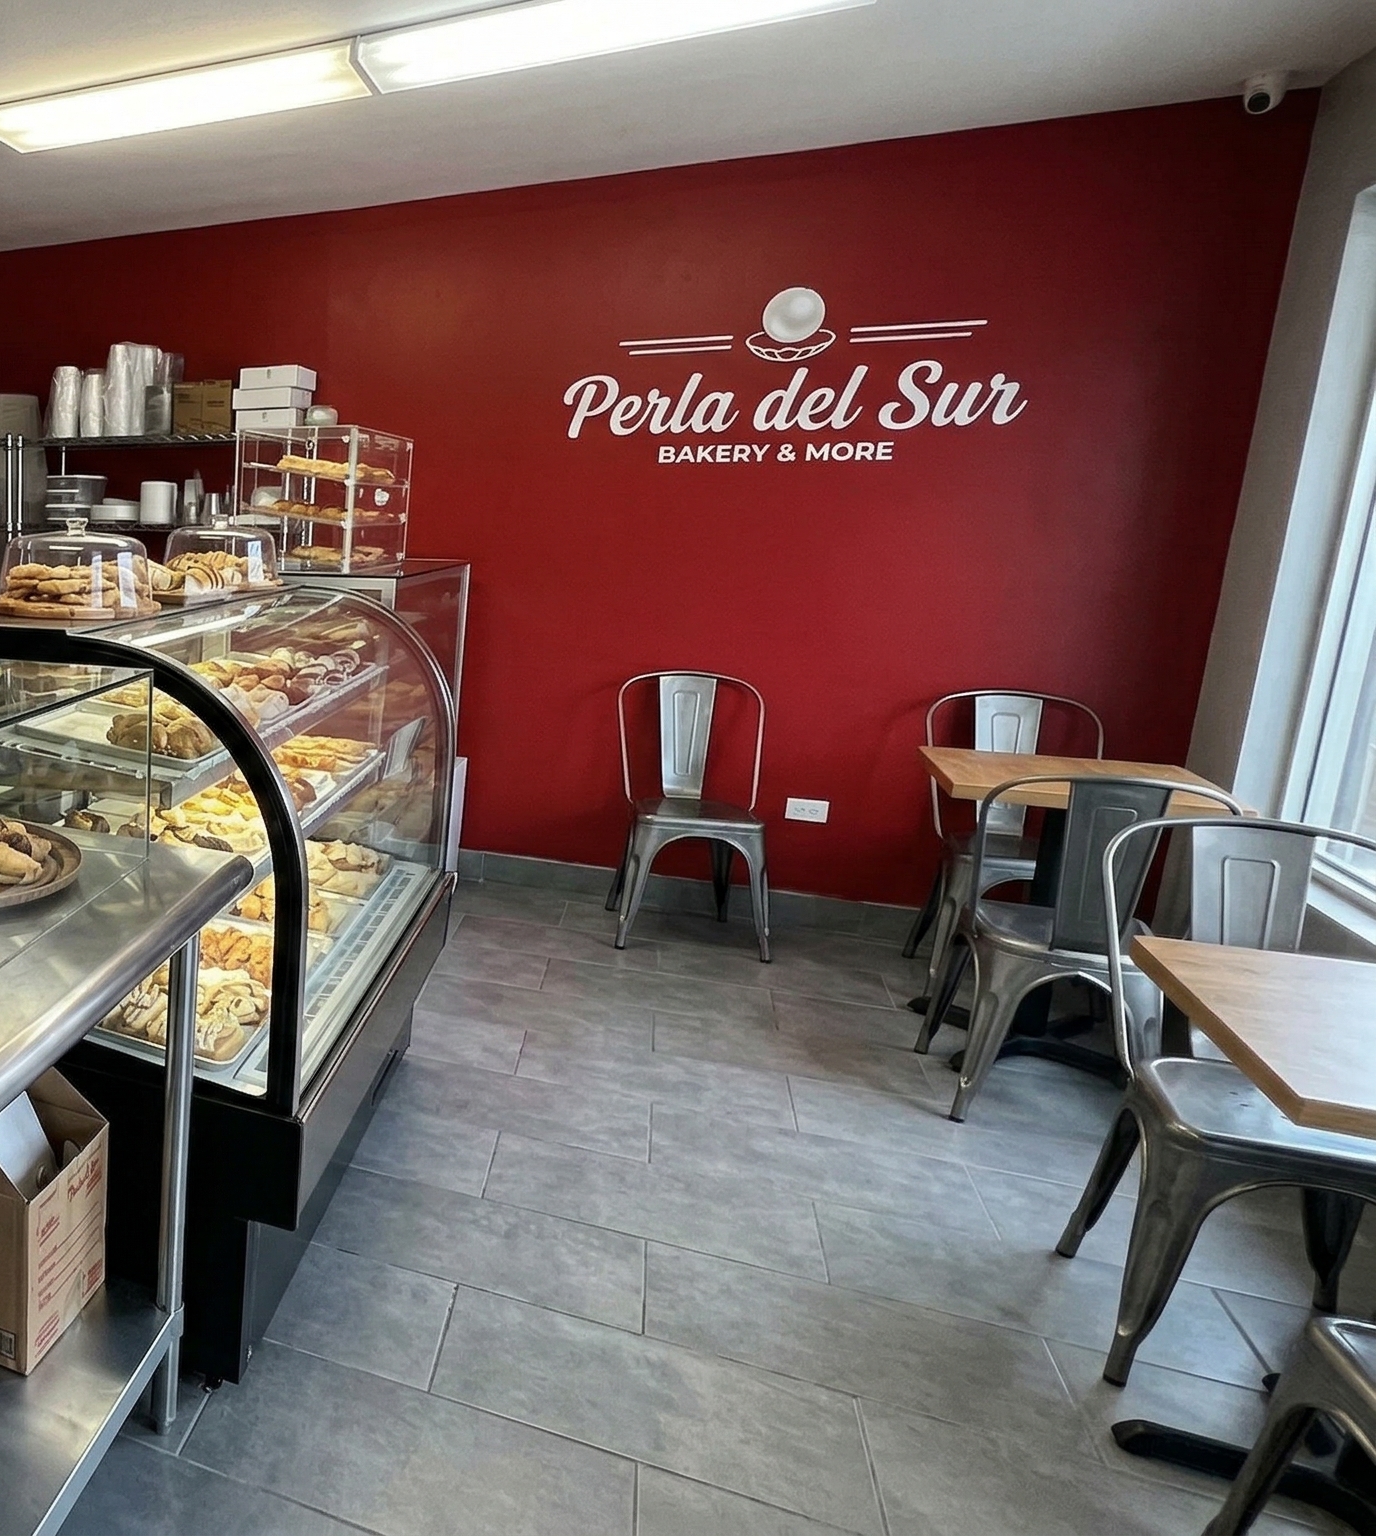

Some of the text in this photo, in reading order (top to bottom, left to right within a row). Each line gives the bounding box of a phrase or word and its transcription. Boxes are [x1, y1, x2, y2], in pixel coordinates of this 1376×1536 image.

[563, 359, 1028, 439] Perla del Sur
[658, 441, 894, 464] BAKERY & MORE
